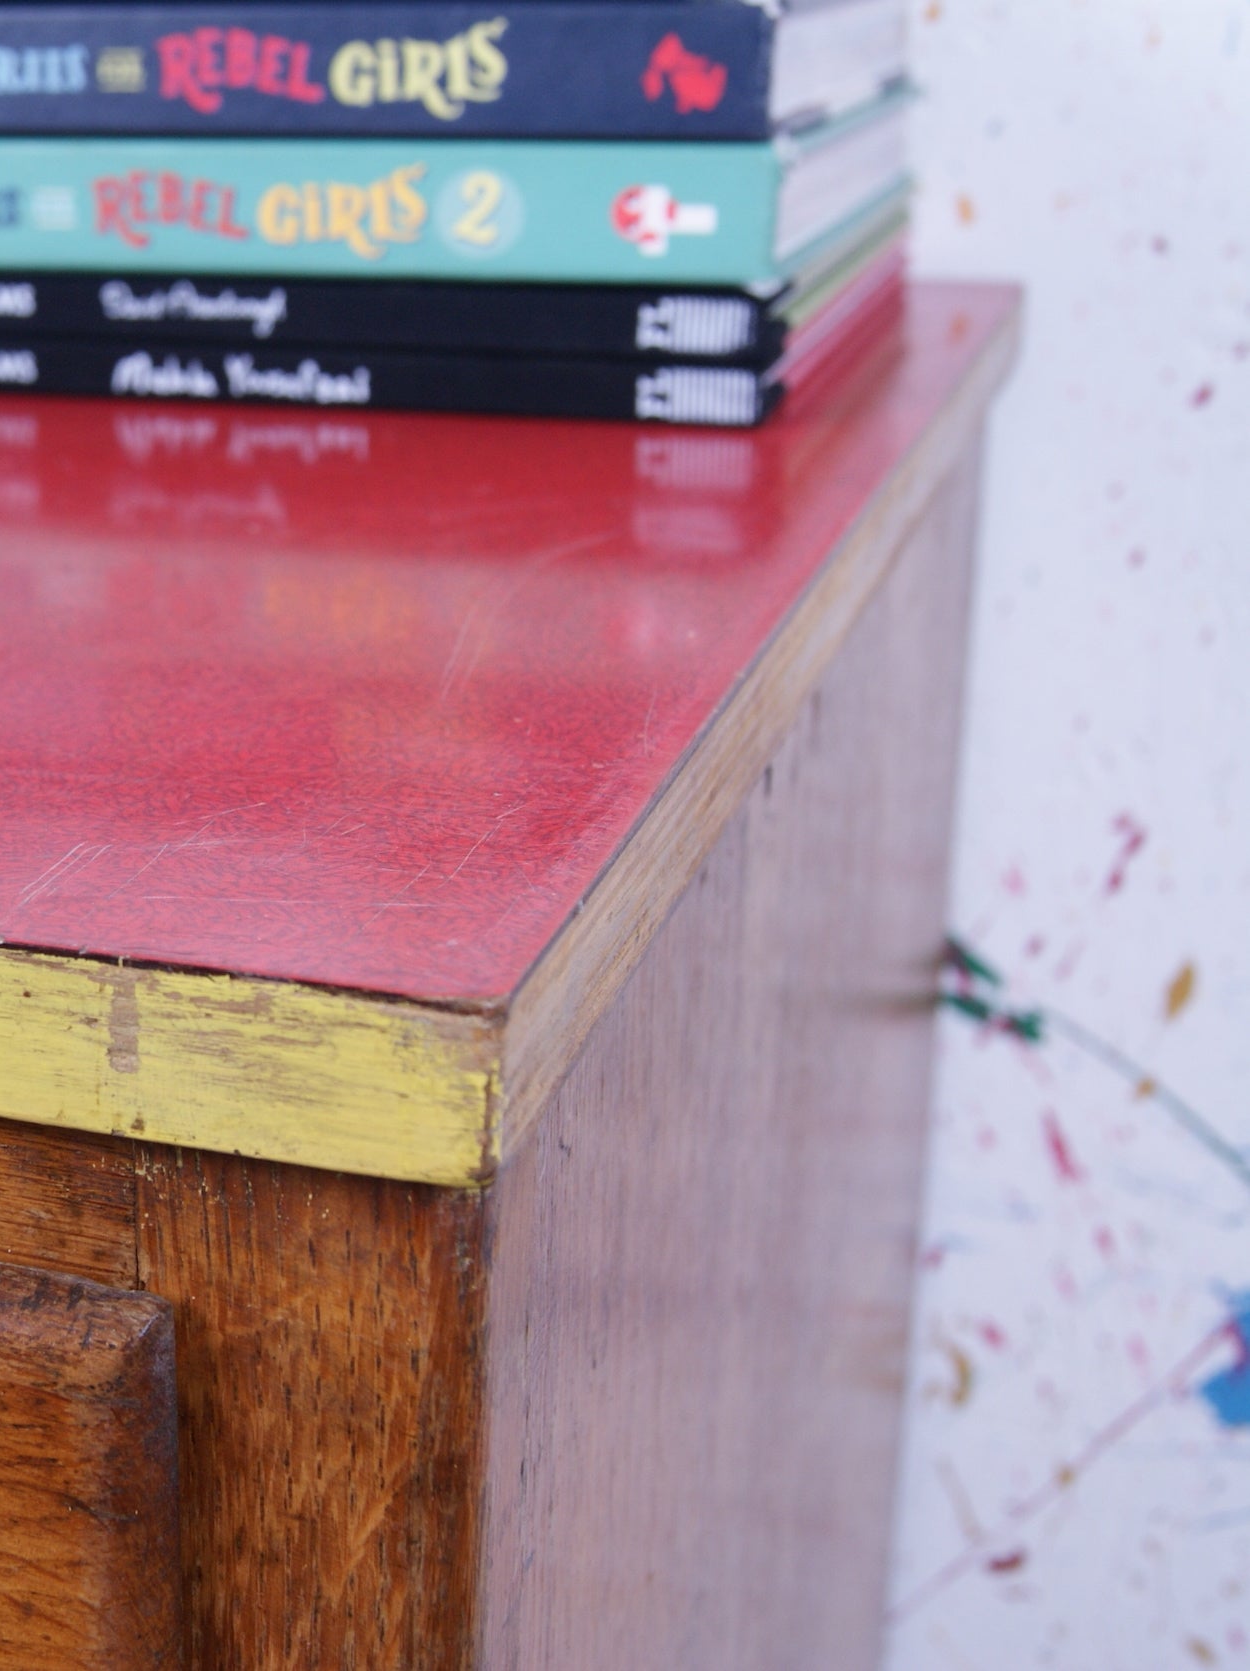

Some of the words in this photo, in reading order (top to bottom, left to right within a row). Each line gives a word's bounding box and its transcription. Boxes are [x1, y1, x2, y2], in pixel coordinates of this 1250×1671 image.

[156, 27, 324, 113] REBEL
[91, 169, 249, 248] REBEL
[454, 172, 500, 245] 2
